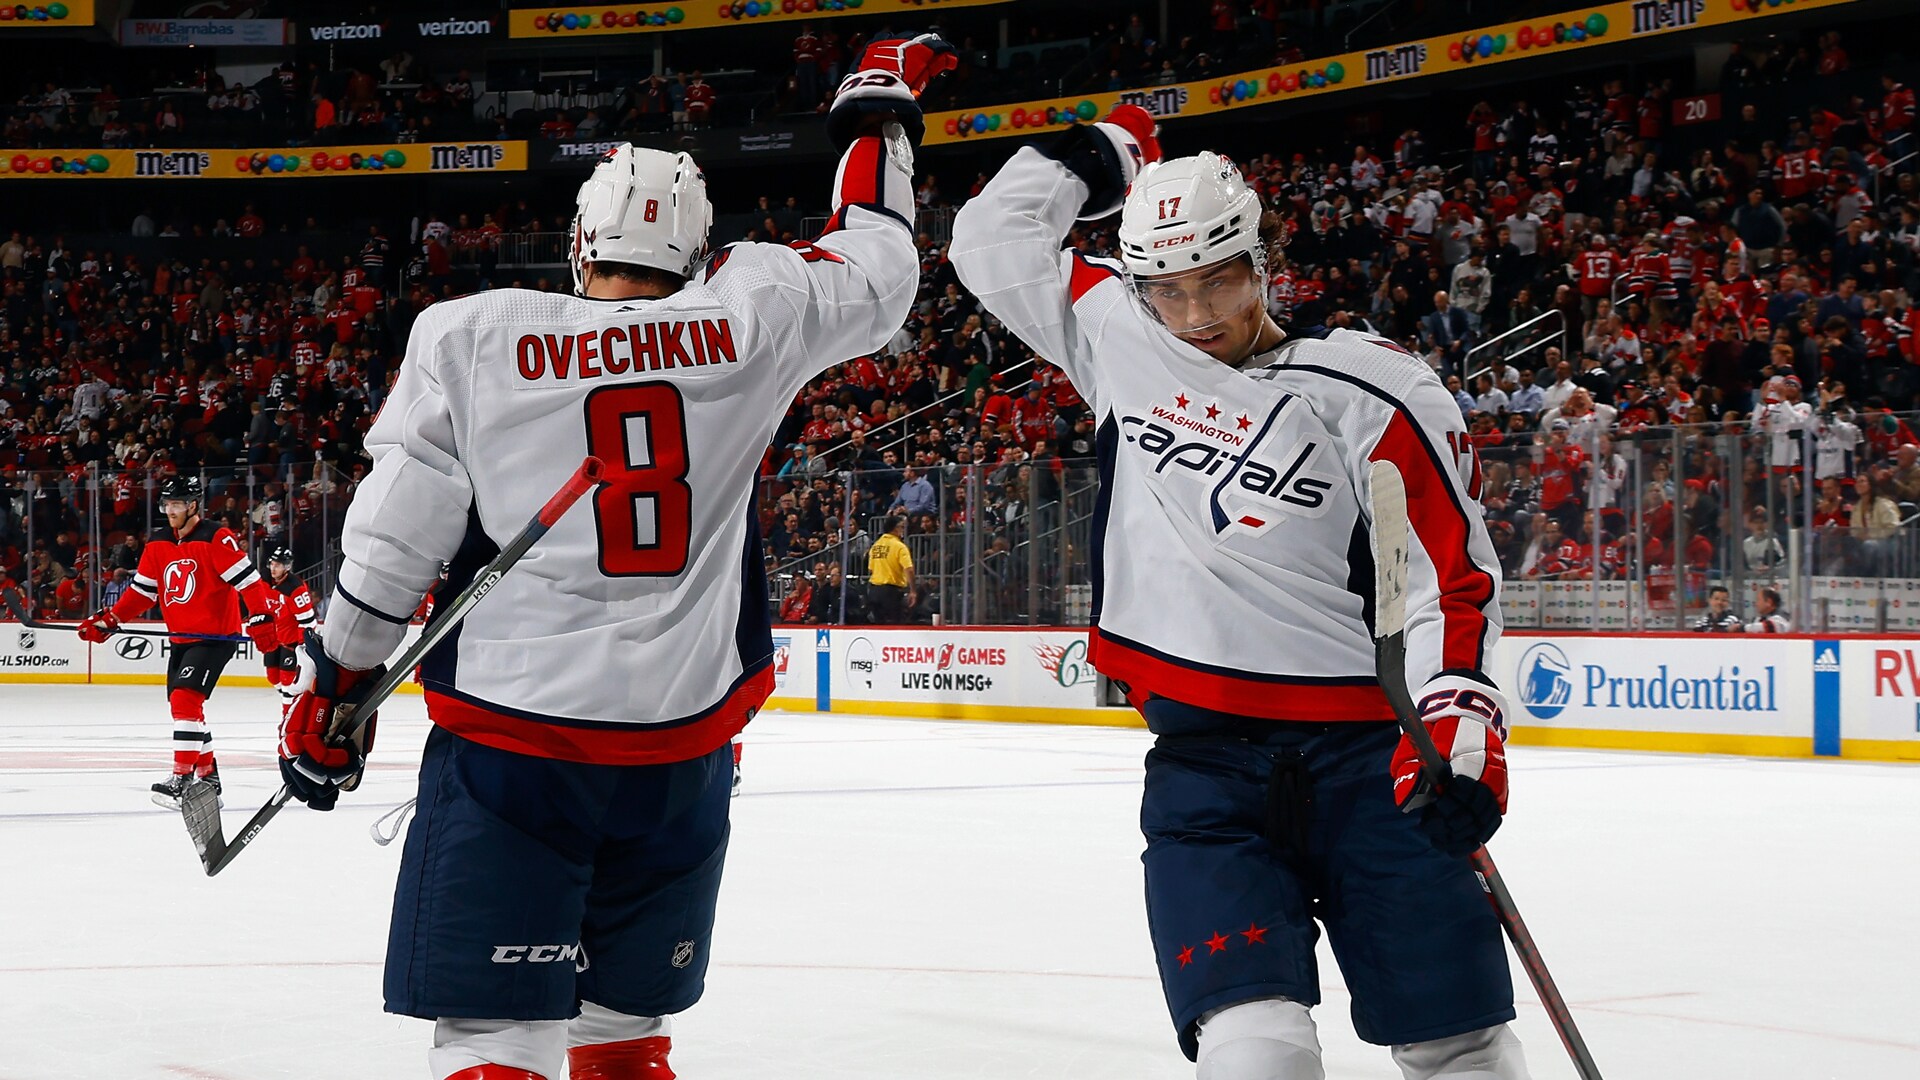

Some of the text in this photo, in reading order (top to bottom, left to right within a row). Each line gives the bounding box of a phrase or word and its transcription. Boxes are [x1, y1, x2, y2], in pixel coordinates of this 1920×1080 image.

[310, 22, 381, 40] verizon
[418, 17, 491, 36] verizon
[1685, 99, 1707, 120] 20
[1785, 158, 1804, 179] 13
[644, 199, 658, 223] 8
[1158, 197, 1182, 220] 17
[1153, 234, 1195, 249] CCM
[1587, 258, 1611, 279] 13
[343, 273, 357, 288] 30
[295, 349, 314, 366] 63
[516, 319, 738, 380] OVECHKIN
[1151, 406, 1245, 447] WASHINGTON
[1446, 431, 1482, 500] 17
[584, 380, 693, 577] 8
[222, 536, 239, 551] 7
[473, 574, 498, 600] CCM
[294, 591, 311, 608] 86
[881, 646, 1006, 666] STREAM GAMES
[901, 672, 993, 692] LIVE ON MSG+
[1583, 664, 1778, 712] Prudential
[241, 824, 262, 845] CCM
